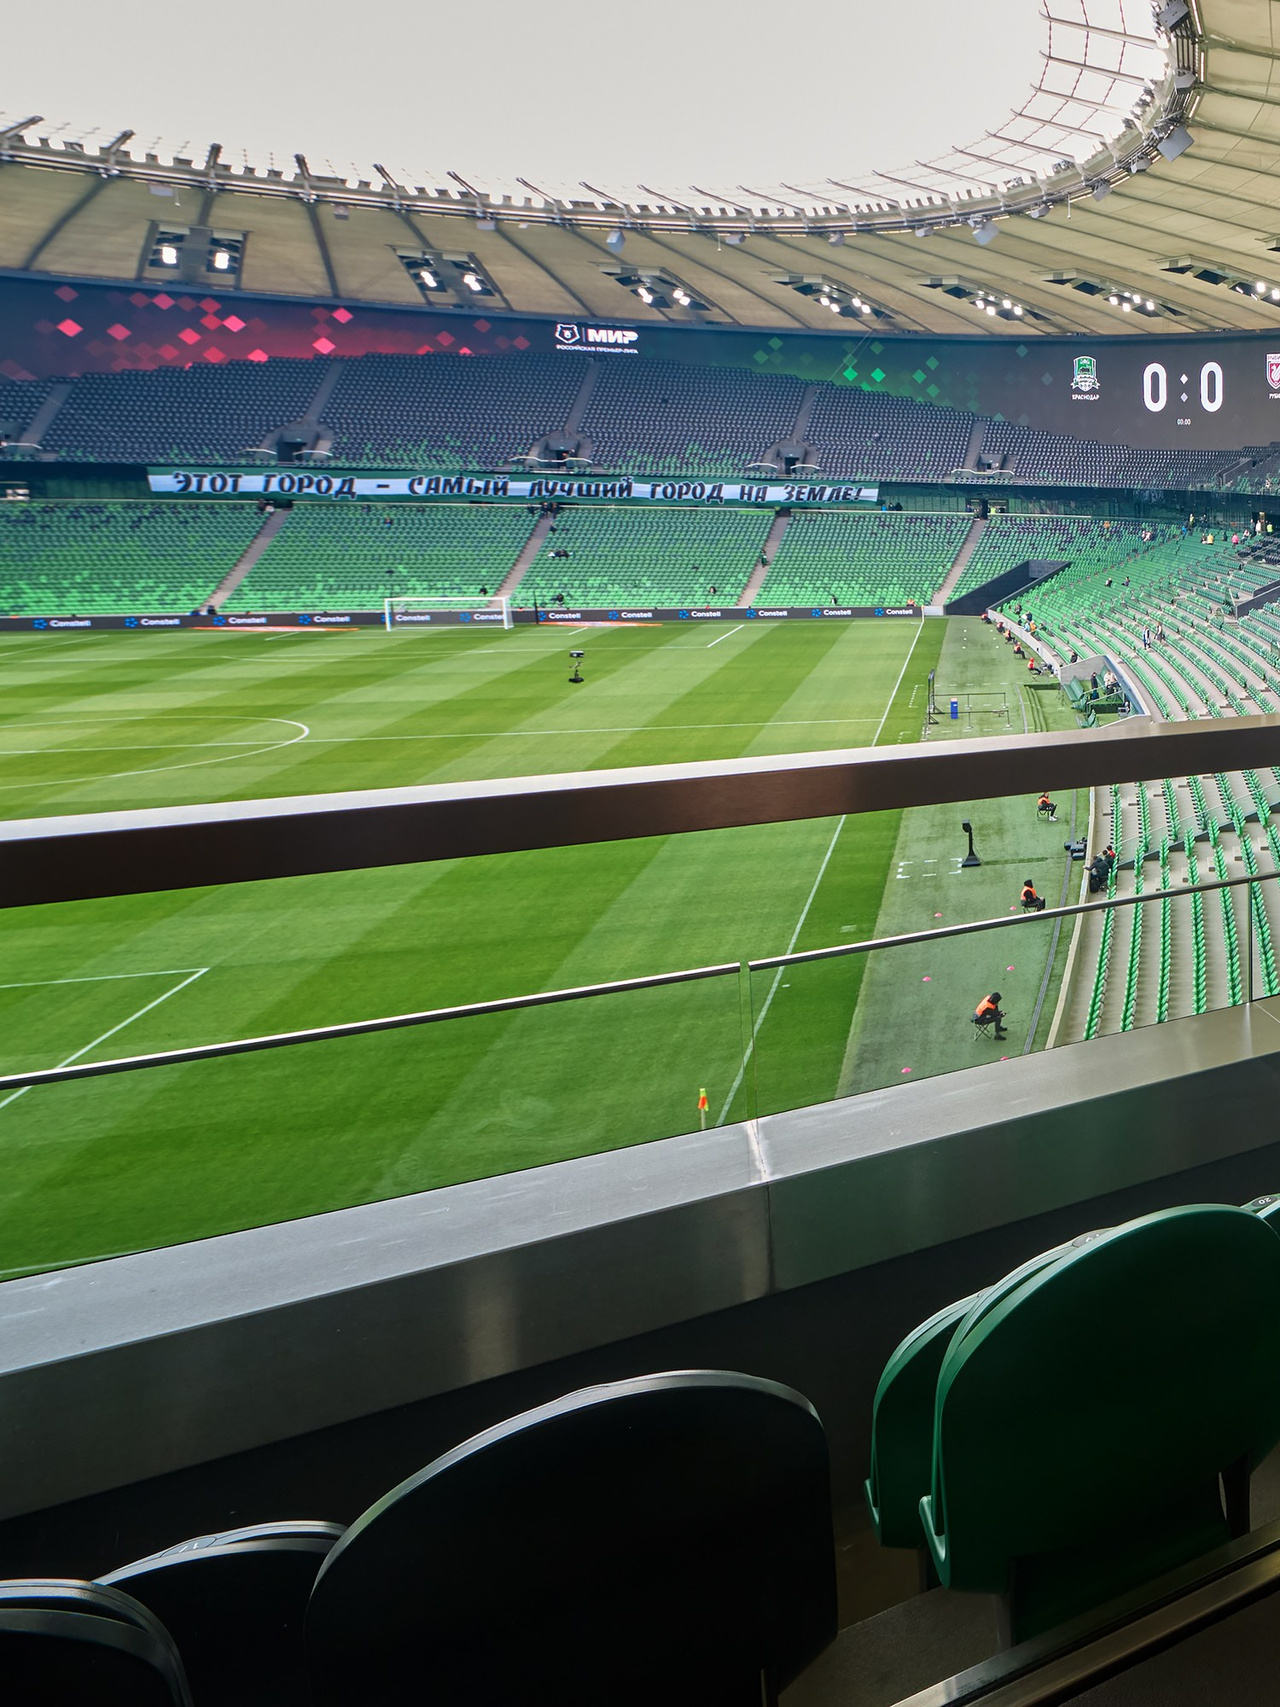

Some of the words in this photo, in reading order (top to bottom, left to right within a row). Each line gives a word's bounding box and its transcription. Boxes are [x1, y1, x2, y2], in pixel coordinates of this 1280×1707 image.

[587, 329, 639, 344] МИР
[173, 471, 243, 494] ЭТОТ
[262, 474, 357, 500] ГОРОД
[408, 474, 510, 498] САМЫЙ
[527, 475, 634, 500] ЛУЧШИЙ
[649, 480, 725, 505] ГОРОД
[739, 483, 769, 503] НА
[782, 484, 865, 504] ЗЕМЛЕ!
[691, 610, 721, 618] Constell
[758, 609, 788, 617] Constell
